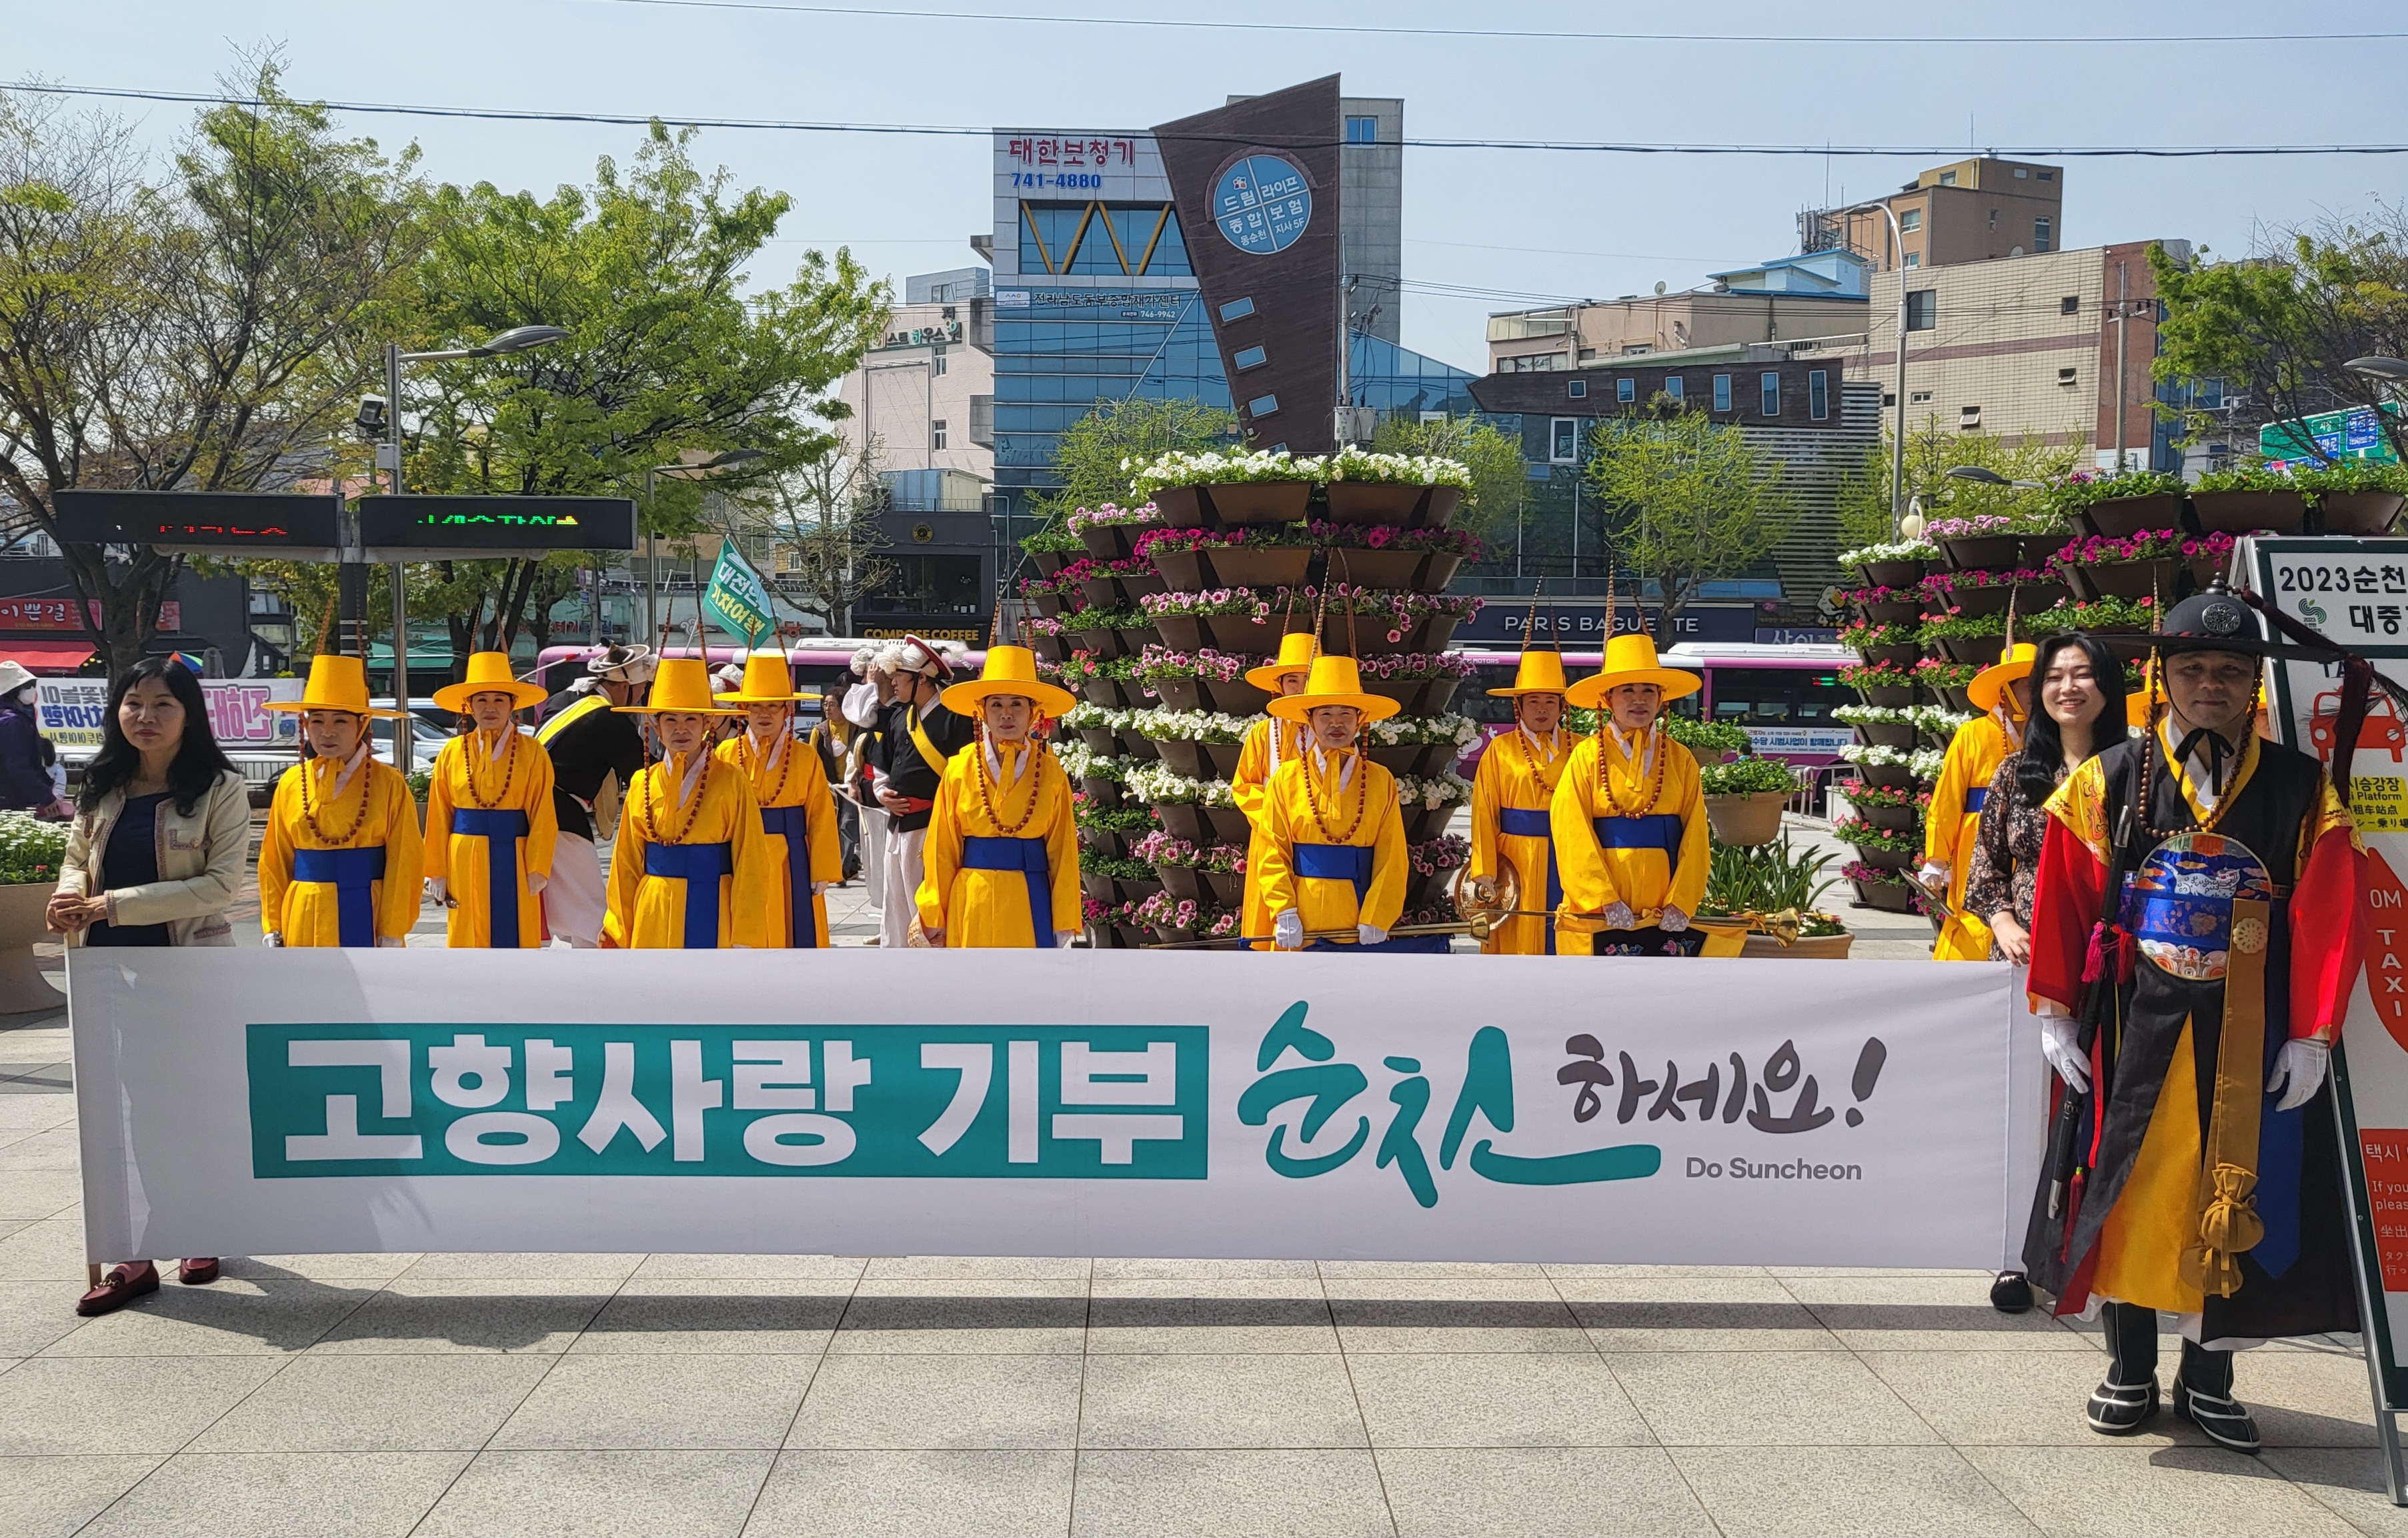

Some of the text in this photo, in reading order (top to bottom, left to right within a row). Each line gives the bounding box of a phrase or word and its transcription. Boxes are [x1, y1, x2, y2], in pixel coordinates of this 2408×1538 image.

[1009, 137, 1135, 167] 대한보청기
[1010, 172, 1102, 189] 741-4880
[1224, 176, 1300, 213] 드림 라이프
[1228, 198, 1303, 234] 종합 보험
[1240, 217, 1305, 246] 동순천 지사 5F
[1140, 310, 1176, 318] 746-9942
[2313, 437, 2338, 454] 마로
[2279, 565, 2407, 594] 2023순천
[1, 603, 65, 622] 이쁜걸
[711, 582, 766, 636] 기차여행
[1504, 616, 1698, 632] PARIS BAGUETE
[1817, 614, 1846, 627] 4.2
[2349, 605, 2408, 635] 대중
[864, 628, 979, 641] COMPOSE COFFEE
[2318, 661, 2375, 678] TAI
[1749, 737, 1848, 746] 수당 시범사업이 함께합니다
[2349, 777, 2400, 792] 시승강장
[2357, 791, 2402, 801] Platform
[2349, 804, 2399, 815] 租车站点
[2376, 929, 2405, 1016] TAXI
[284, 1033, 1183, 1167] 고향사랑 기부
[1237, 1000, 1888, 1209] 순천 하세요!
[2365, 1143, 2401, 1163] 택시
[1685, 1156, 1863, 1181] Do Suncheon
[2372, 1180, 2408, 1195] If you
